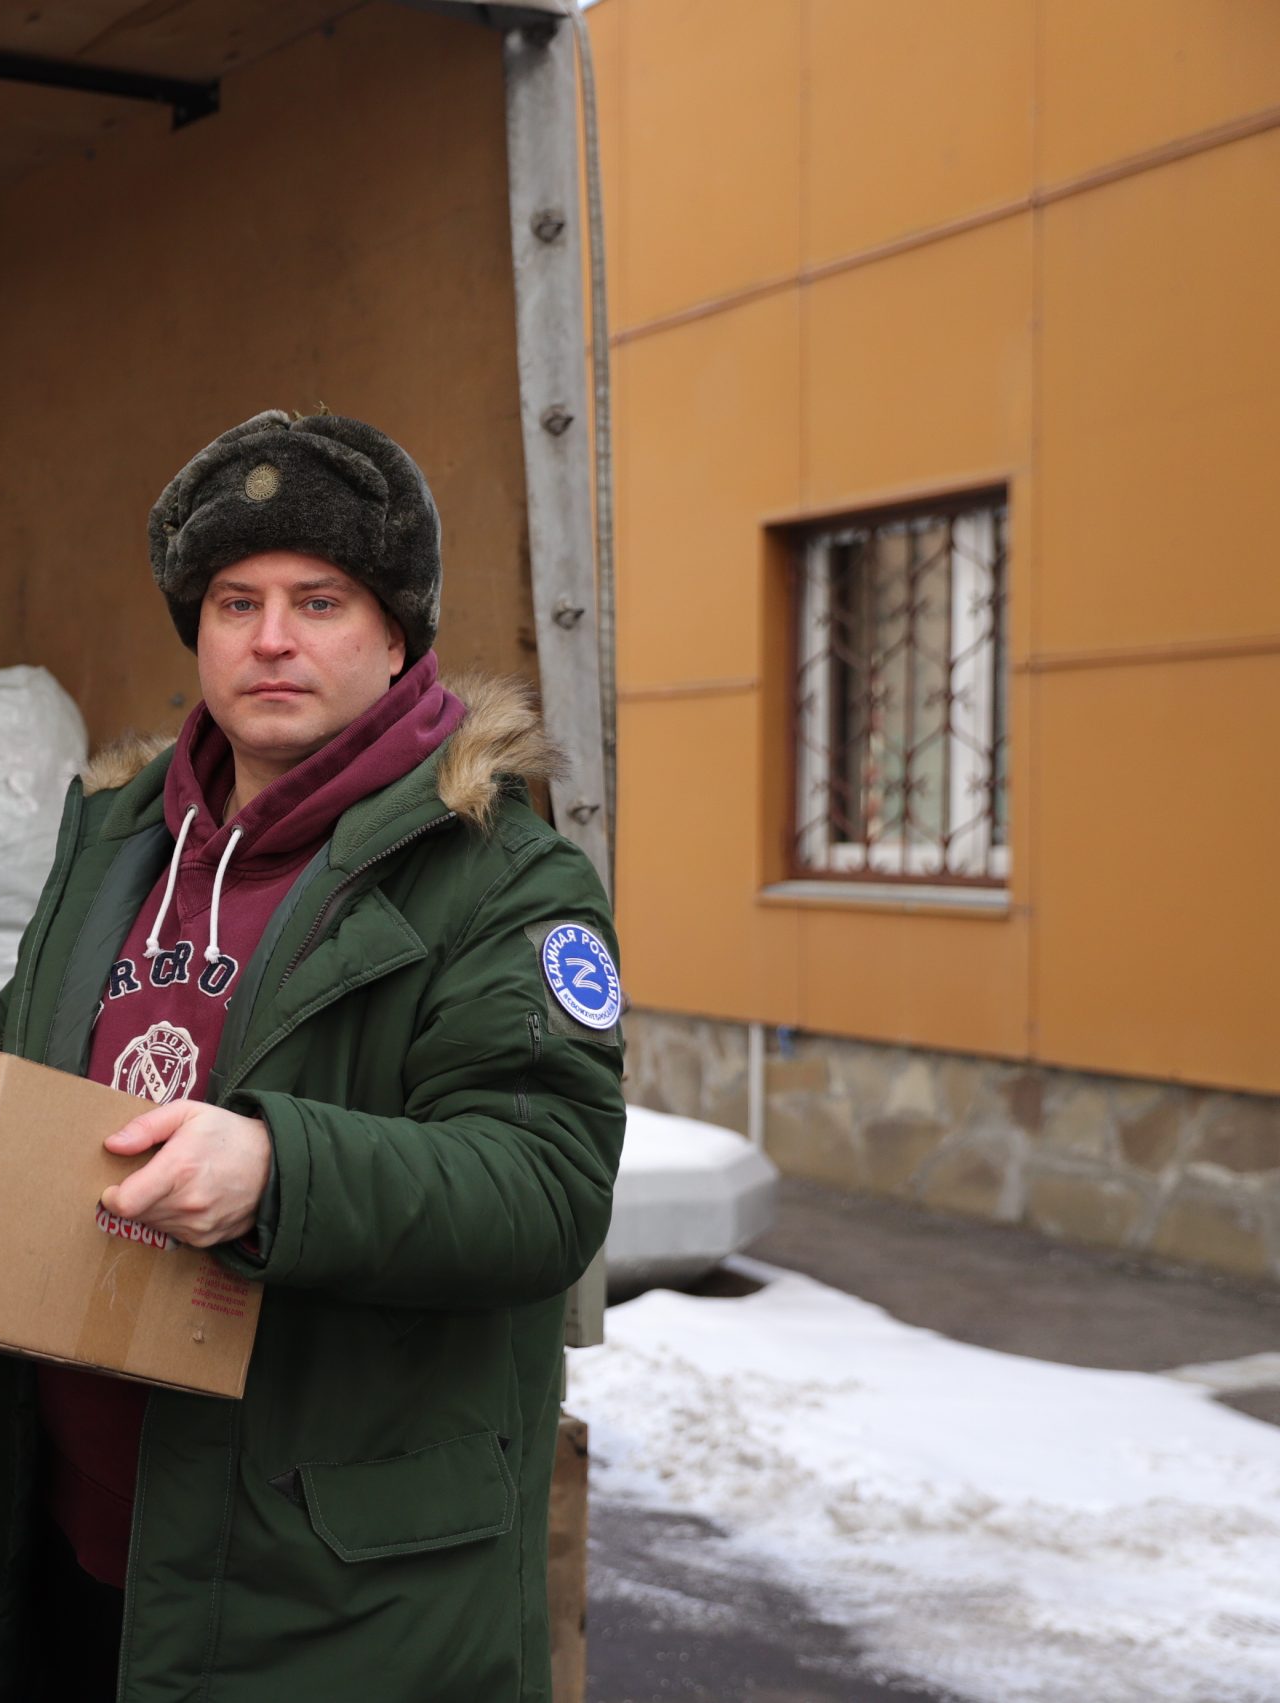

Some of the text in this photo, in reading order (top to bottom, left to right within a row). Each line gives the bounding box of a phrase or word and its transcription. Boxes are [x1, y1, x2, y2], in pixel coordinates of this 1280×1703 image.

[547, 929, 618, 1001] ЕДИНАЯ РОССИЯ
[135, 1030, 193, 1065] NEW YORK
[161, 1058, 175, 1074] F
[96, 1204, 167, 1249] азева
